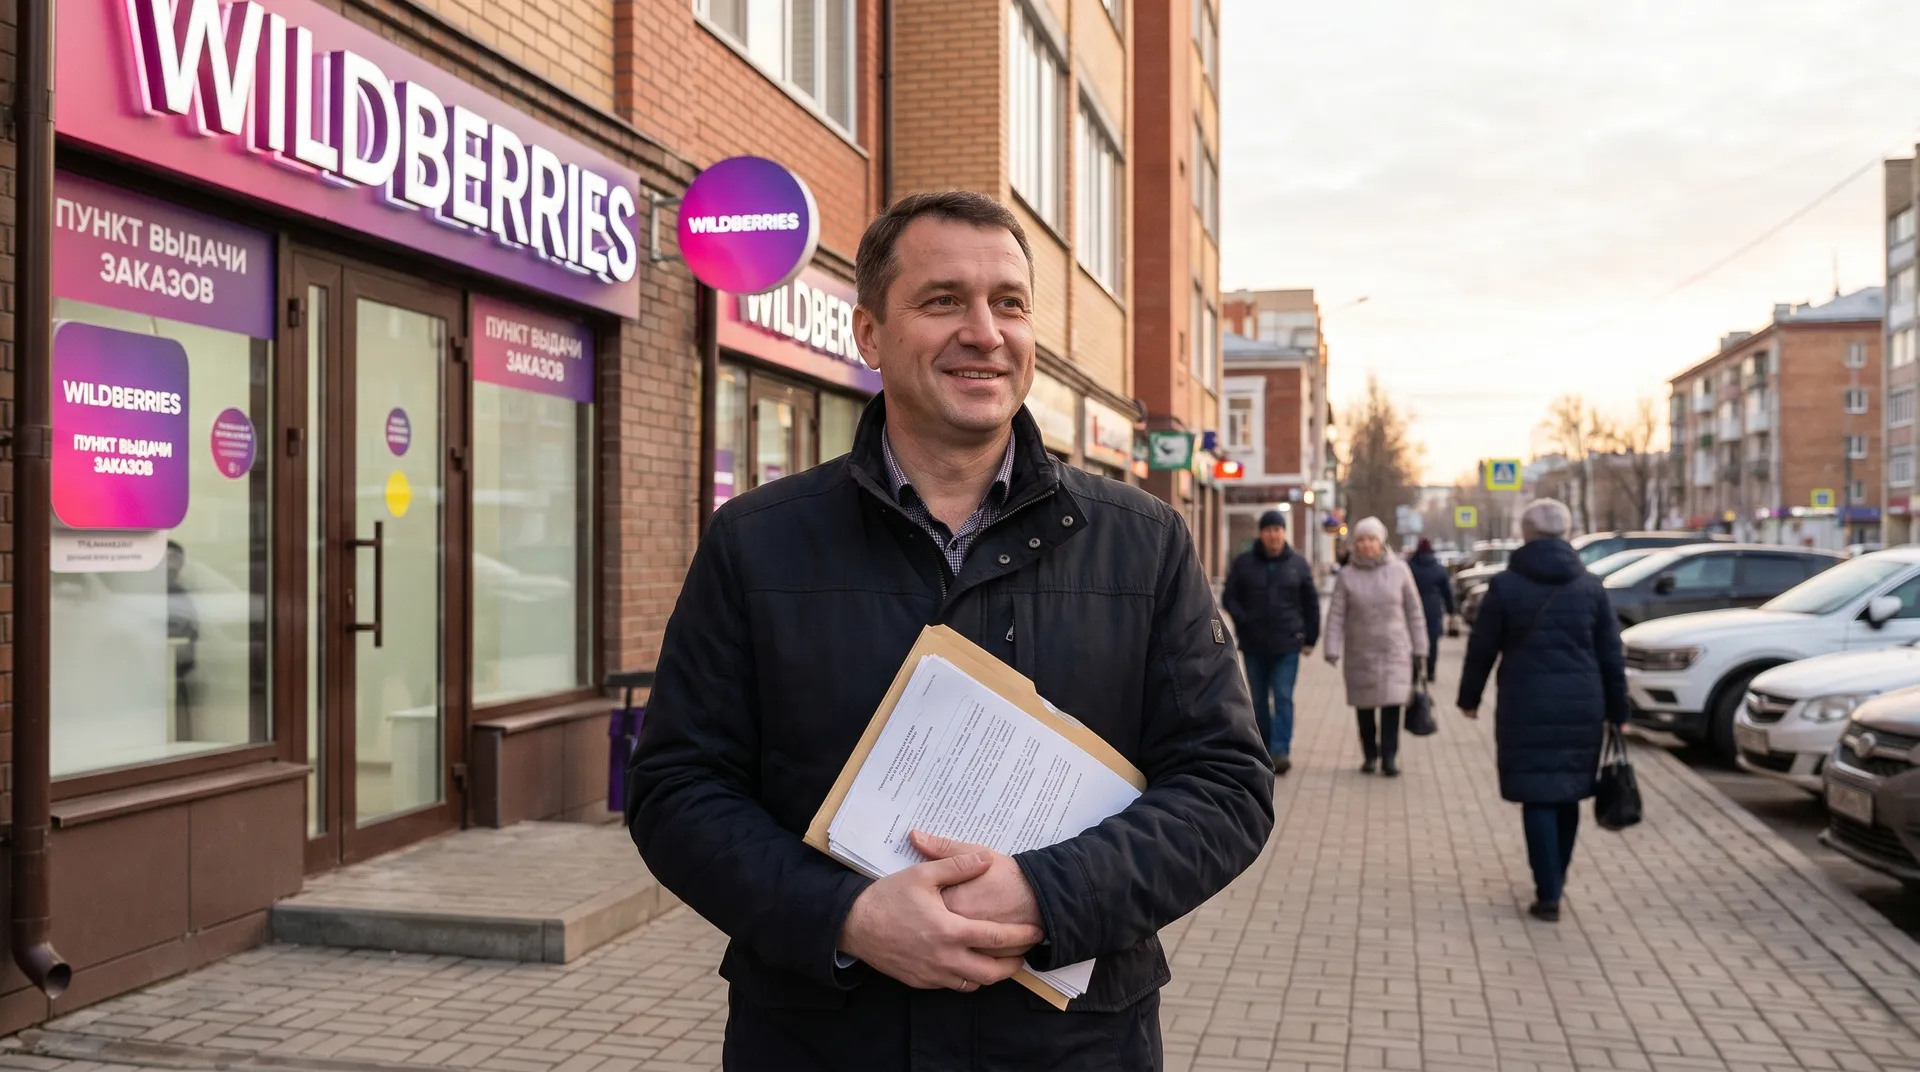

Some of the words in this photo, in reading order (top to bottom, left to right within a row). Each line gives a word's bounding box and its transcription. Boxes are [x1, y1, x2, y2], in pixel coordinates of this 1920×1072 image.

[150, 0, 637, 283] WILDBERRIES
[56, 198, 143, 247] ПУНКТ
[149, 222, 247, 275] ВЫДАЧИ
[688, 212, 800, 234] WILDBERRIES
[99, 252, 215, 304] ЗАКАЗОВ
[485, 315, 530, 346] ПУНКТ
[531, 327, 582, 359] ВЫДАЧИ
[747, 279, 868, 366] WILDBER
[506, 350, 565, 382] ЗАКАЗОВ
[63, 379, 182, 415] WILDBERRIES
[73, 434, 117, 454] ПУНКТ
[118, 438, 172, 458] ВЫДАЧИ
[93, 456, 154, 476] ЗАКАЗОВ
